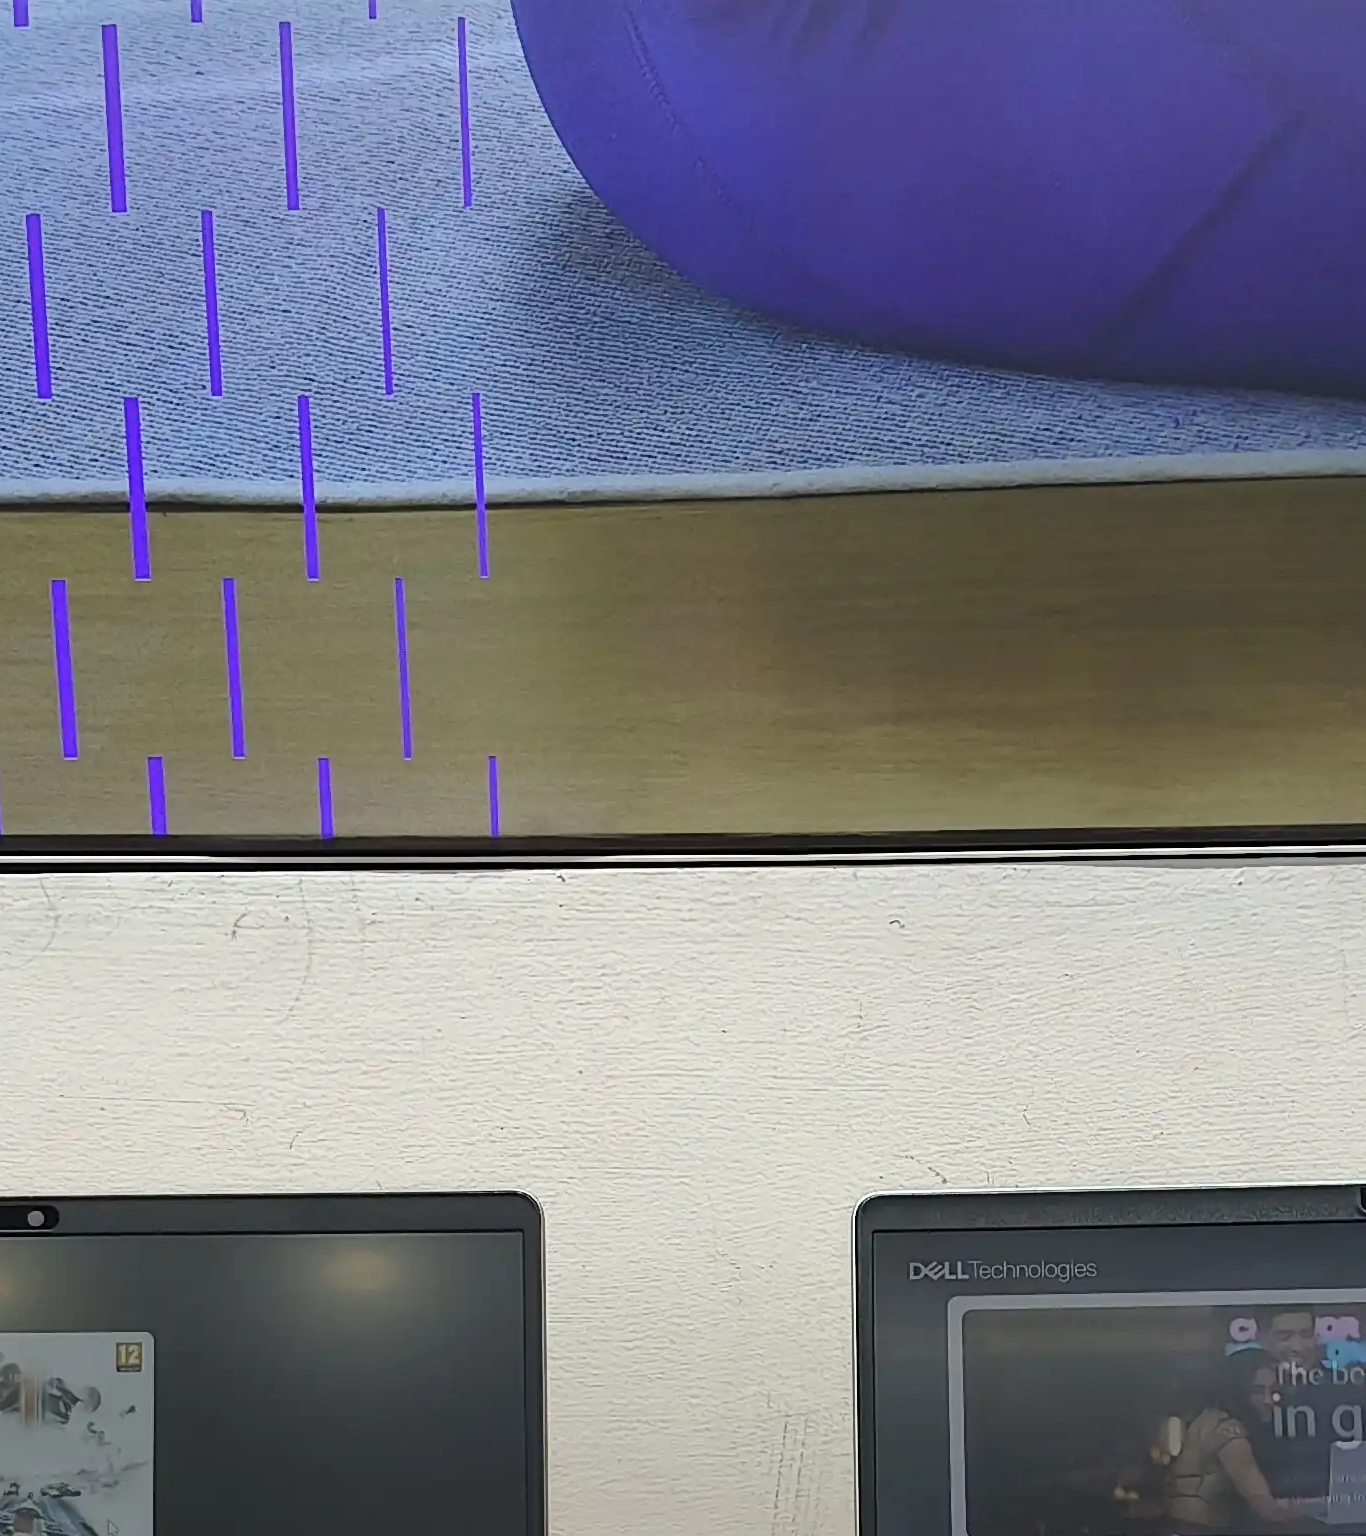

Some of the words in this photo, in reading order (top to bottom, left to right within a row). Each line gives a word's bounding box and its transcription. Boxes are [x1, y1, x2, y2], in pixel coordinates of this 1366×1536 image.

[119, 1344, 140, 1366] 12
[1276, 1361, 1324, 1386] The
[1272, 1393, 1316, 1439] in
